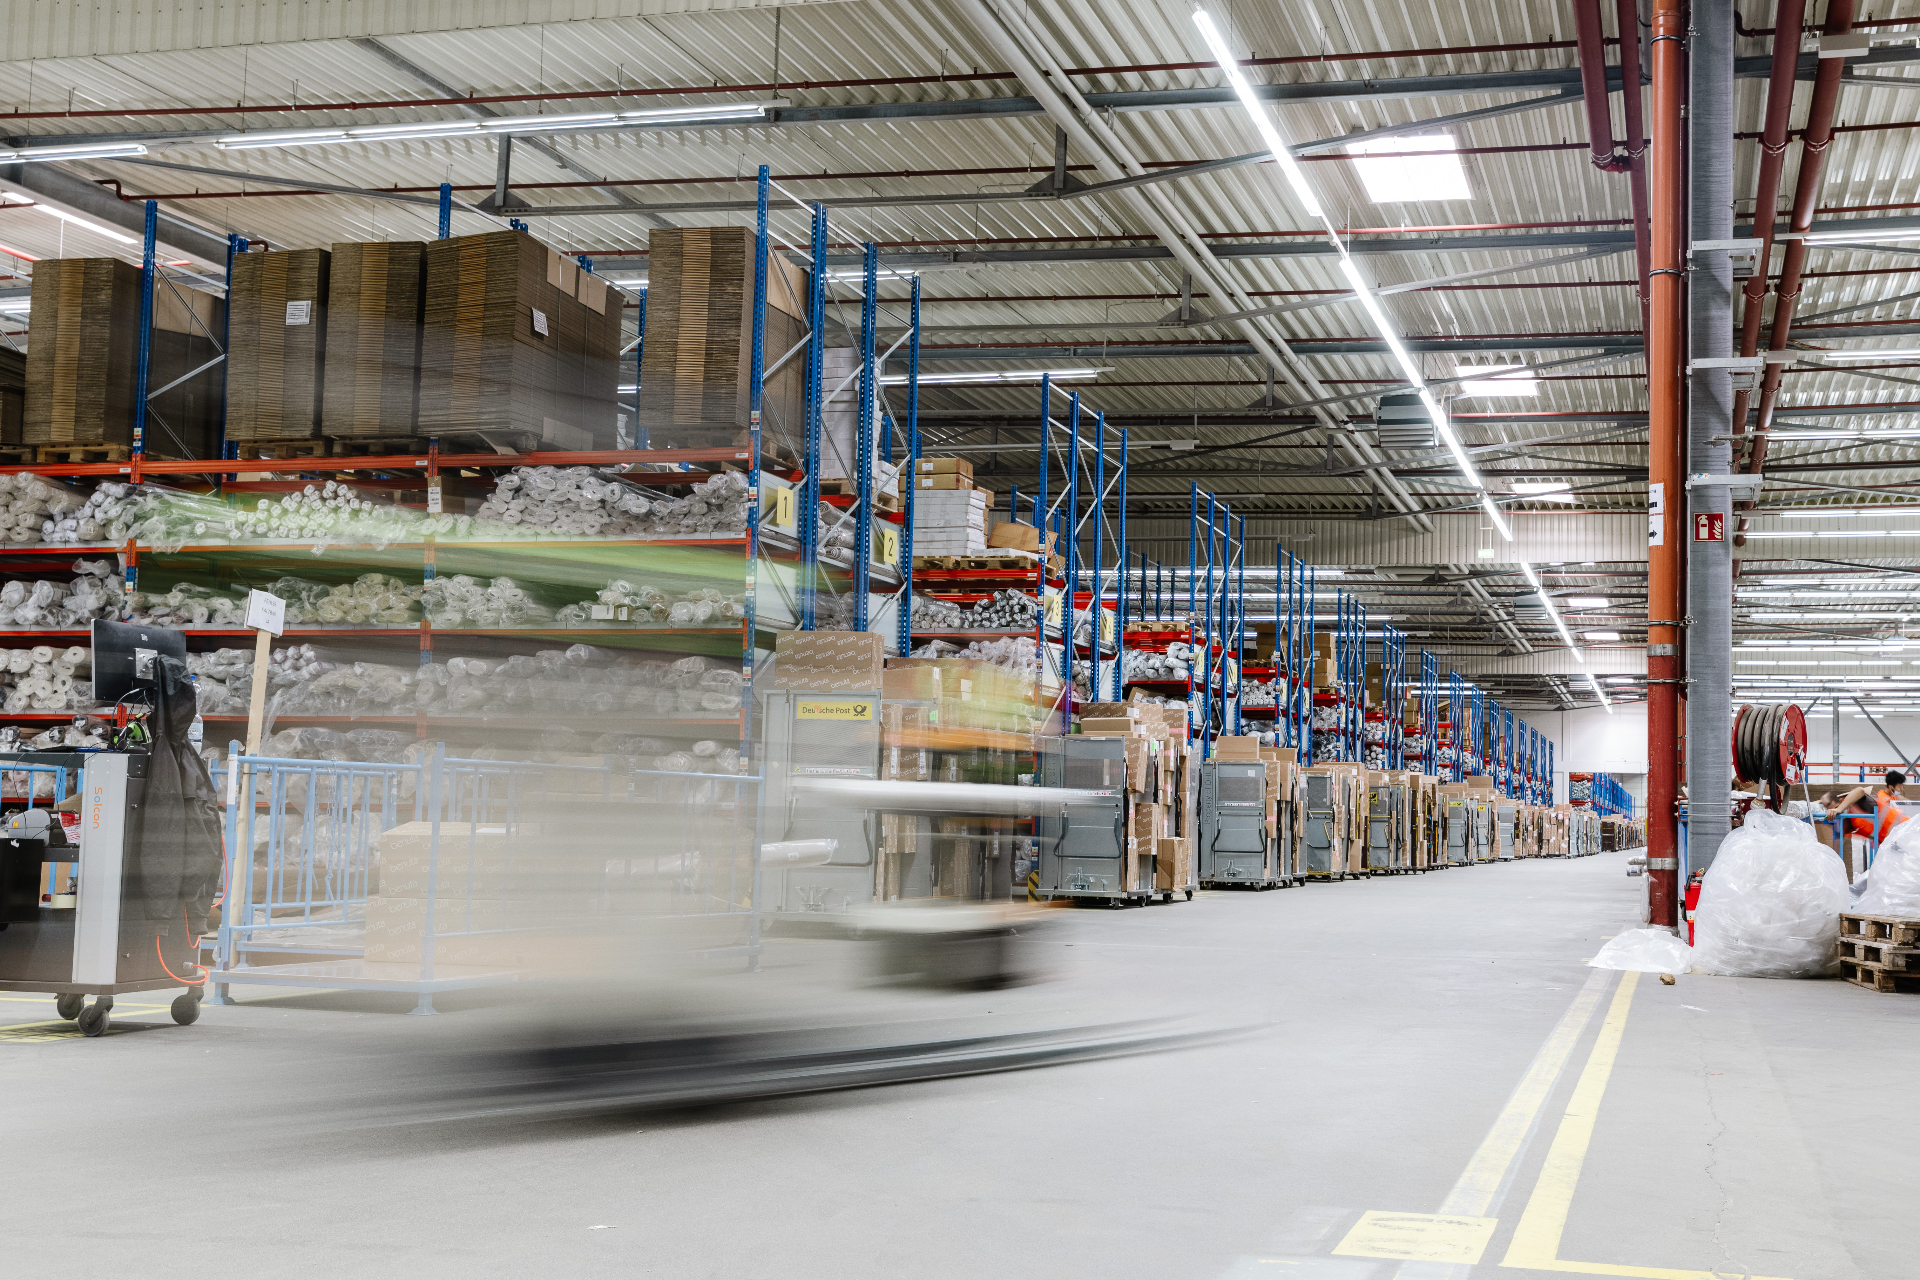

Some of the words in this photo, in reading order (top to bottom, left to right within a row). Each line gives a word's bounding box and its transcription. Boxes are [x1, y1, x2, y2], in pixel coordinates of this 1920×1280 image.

[784, 496, 787, 518] 1
[888, 536, 893, 557] 2
[390, 834, 420, 850] benuta
[422, 836, 451, 850] beuta
[455, 836, 484, 850] benta
[390, 858, 419, 873] benuta
[421, 858, 451, 873] buta
[454, 858, 483, 873] benta
[389, 880, 418, 895] benuta
[420, 880, 450, 896] buta
[453, 881, 483, 896] benta
[366, 898, 386, 910] enuta
[389, 898, 418, 914] benuta
[420, 900, 449, 914] buta
[451, 900, 480, 915] benta
[366, 921, 385, 933] enuta
[388, 921, 416, 936] benuta
[419, 922, 448, 937] buta
[365, 944, 384, 955] enuta
[387, 944, 416, 959] benuta
